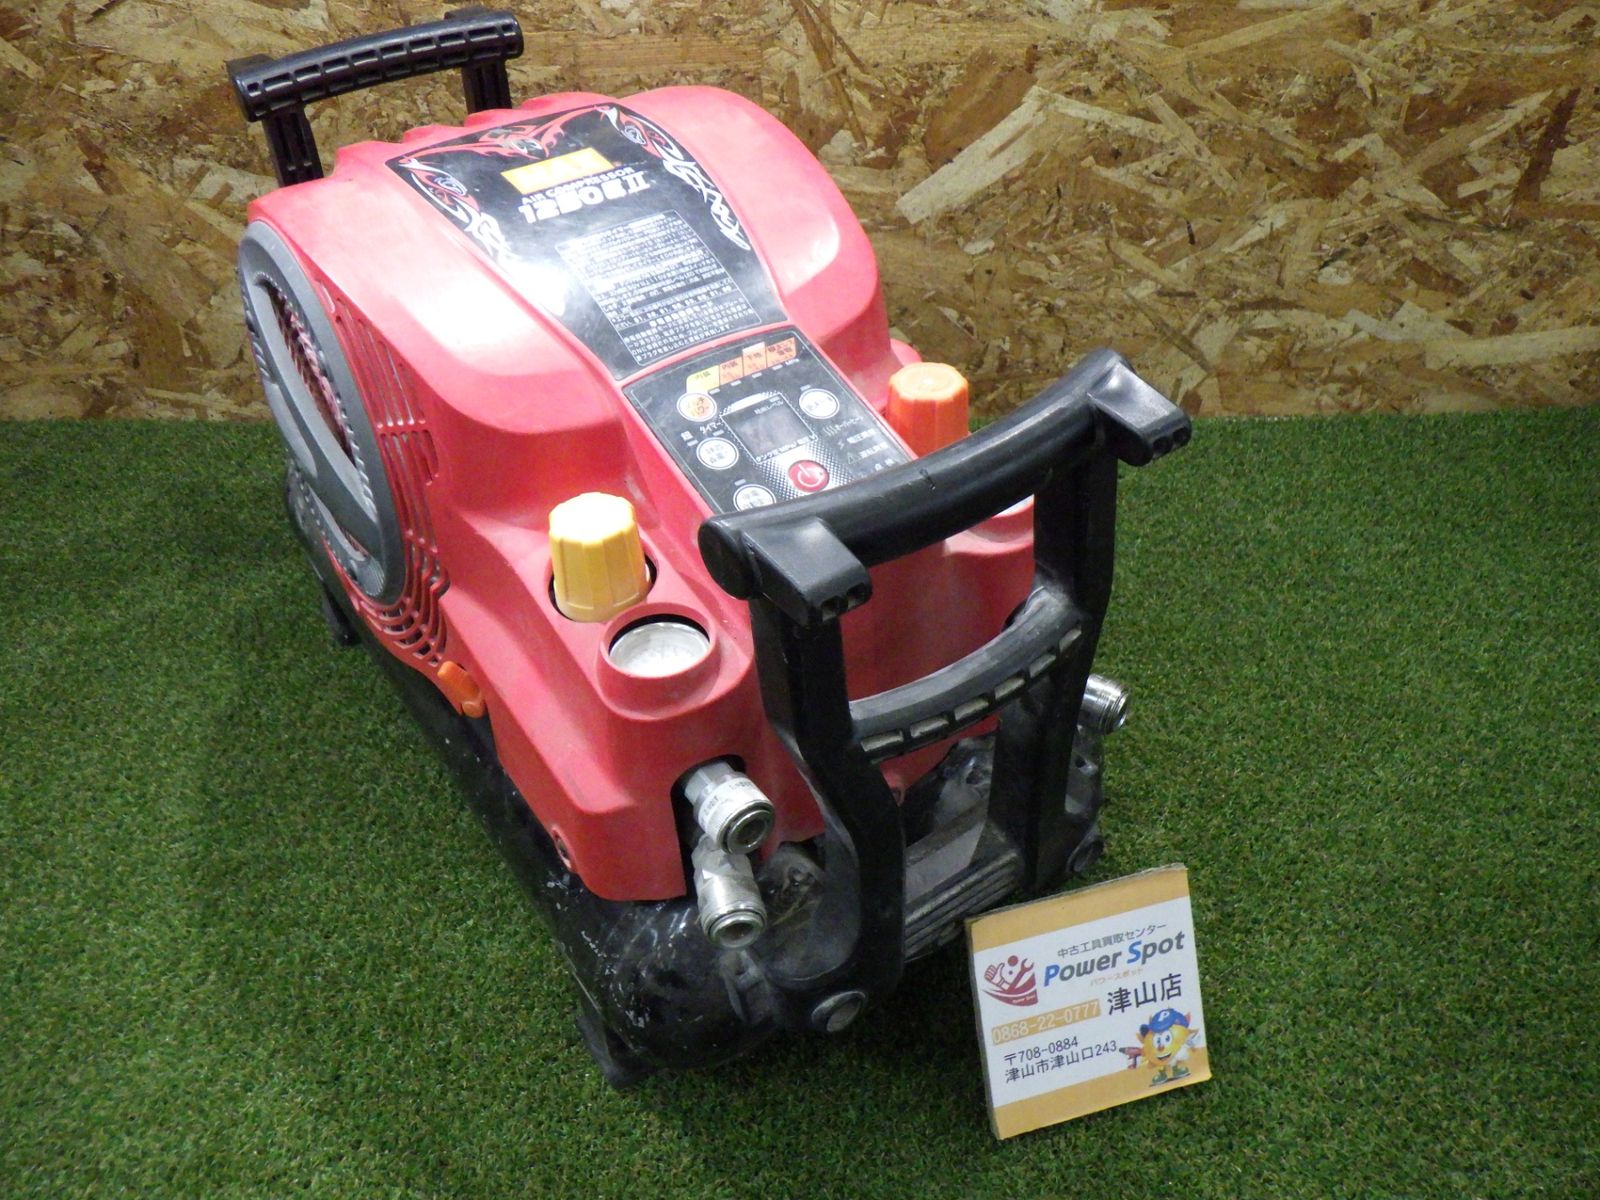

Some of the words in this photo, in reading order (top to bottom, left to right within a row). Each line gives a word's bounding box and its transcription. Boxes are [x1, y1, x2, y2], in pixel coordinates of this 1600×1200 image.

[520, 191, 549, 206] AIR
[546, 166, 636, 198] COMPRESSOR
[1043, 950, 1122, 987] Power
[1126, 930, 1186, 965] Spot
[1057, 924, 1167, 959] 中古工具買取センター
[1107, 973, 1182, 1015] 津山店
[992, 1000, 1099, 1042] 0868-22-0777
[1003, 1036, 1079, 1066] 〒708-0884
